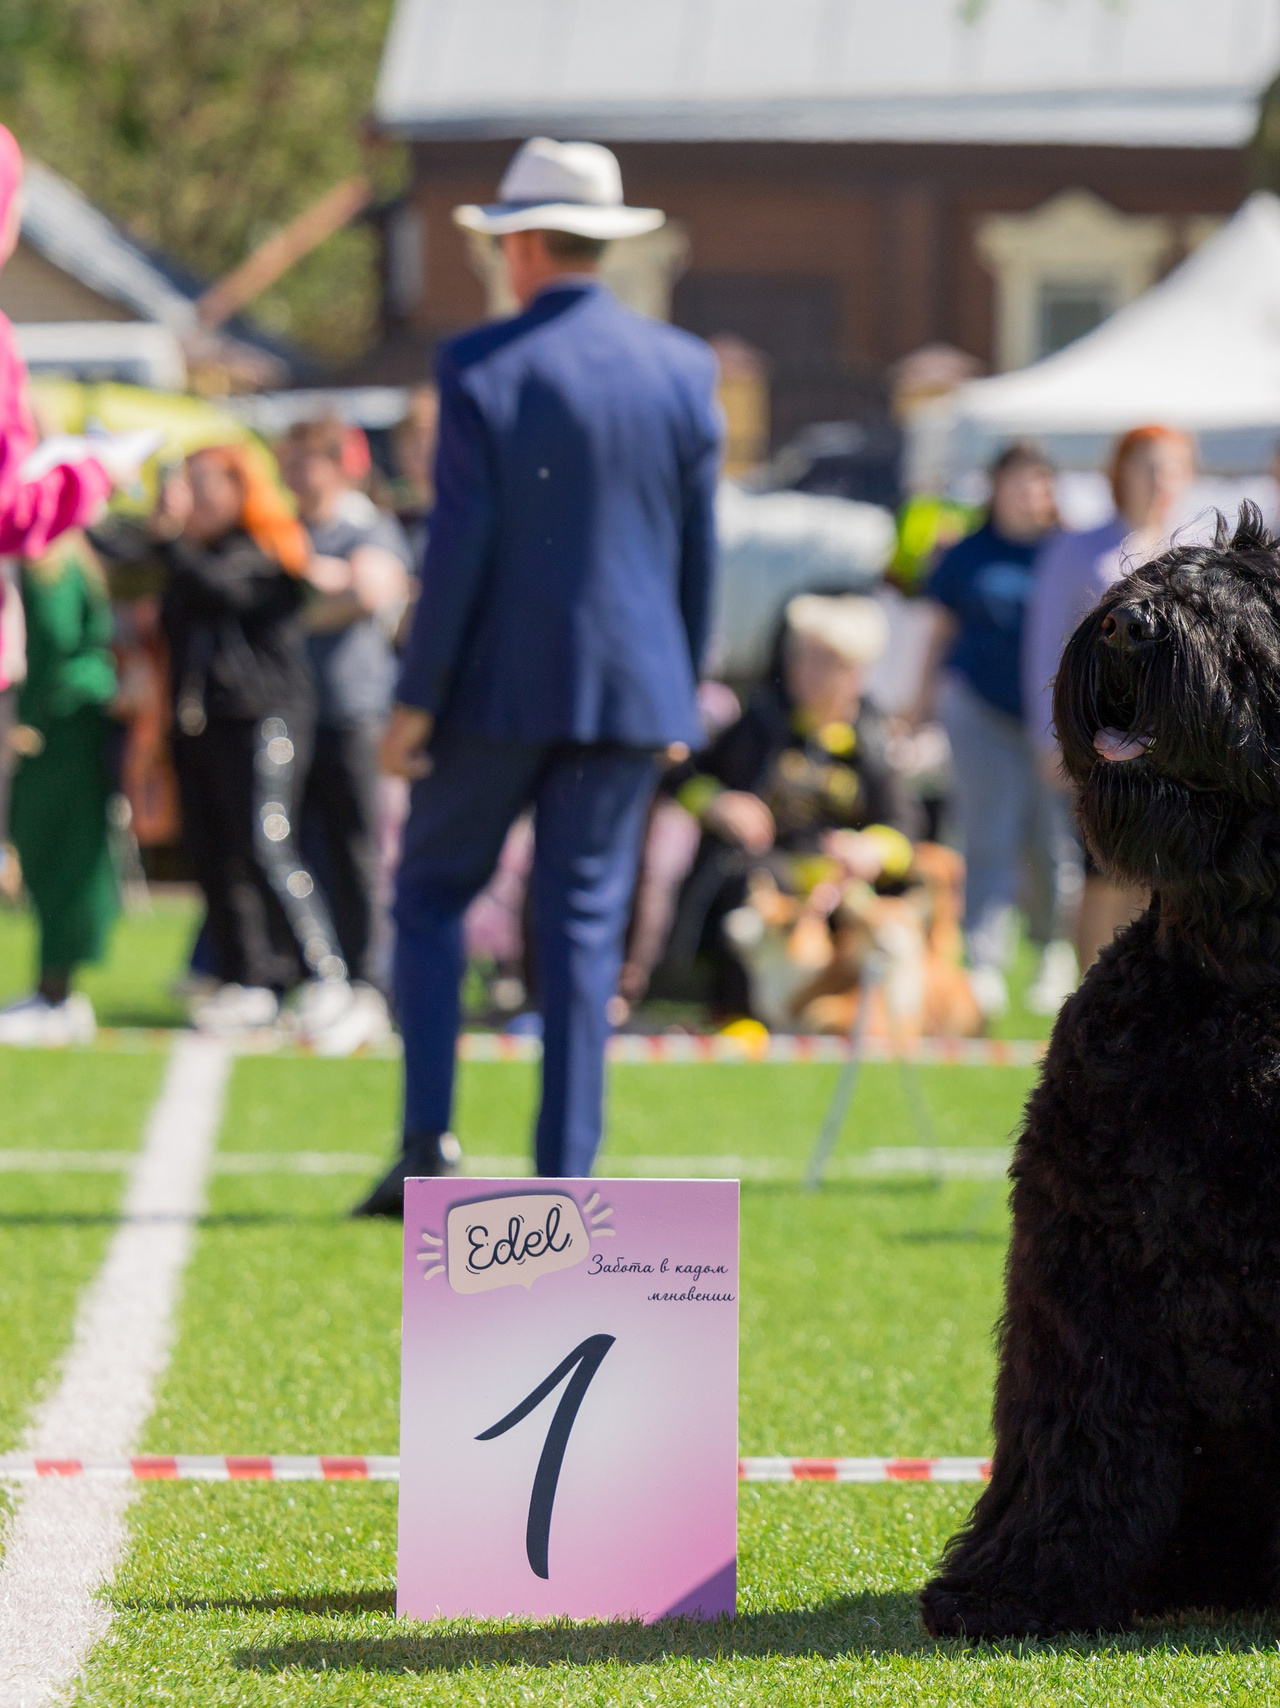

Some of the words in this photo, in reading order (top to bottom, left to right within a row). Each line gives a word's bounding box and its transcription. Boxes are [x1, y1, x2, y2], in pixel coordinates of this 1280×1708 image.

[467, 1205, 571, 1270] Edel
[587, 1253, 655, 1276] Забота
[659, 1257, 671, 1274] в
[674, 1264, 729, 1282] кадом
[647, 1285, 736, 1302] мгновении
[473, 1332, 617, 1581] 1
